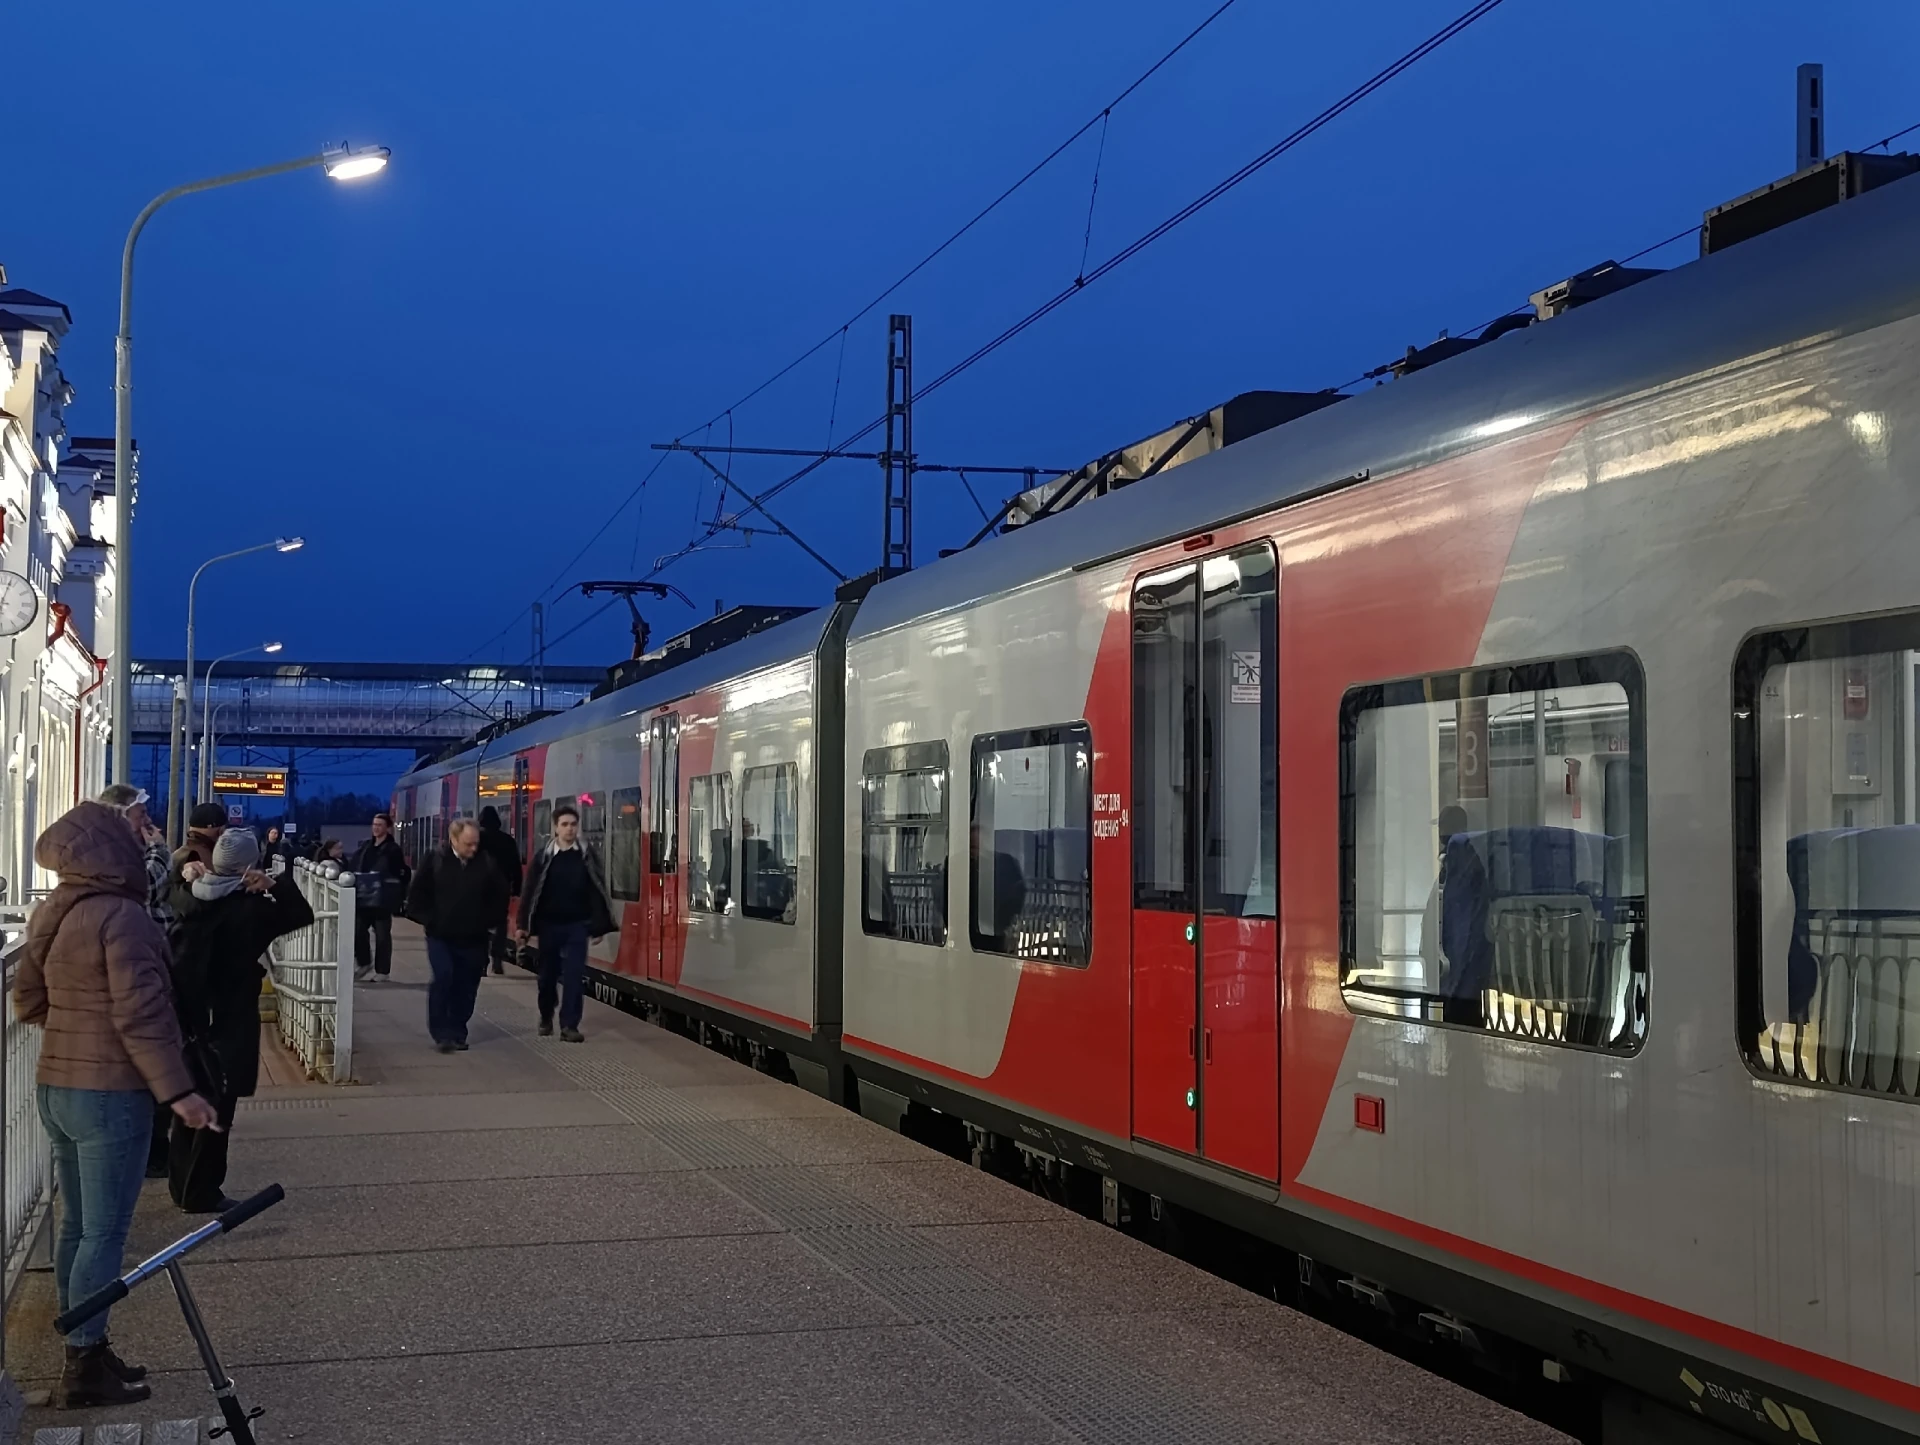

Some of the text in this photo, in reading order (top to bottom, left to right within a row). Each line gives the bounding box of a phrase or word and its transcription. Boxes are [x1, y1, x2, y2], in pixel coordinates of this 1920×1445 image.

[1465, 730, 1478, 776] 3
[237, 772, 243, 780] 3
[1093, 793, 1121, 815] МЕСТ ДЛЯ
[1093, 819, 1119, 841] СИДЕНИЯ
